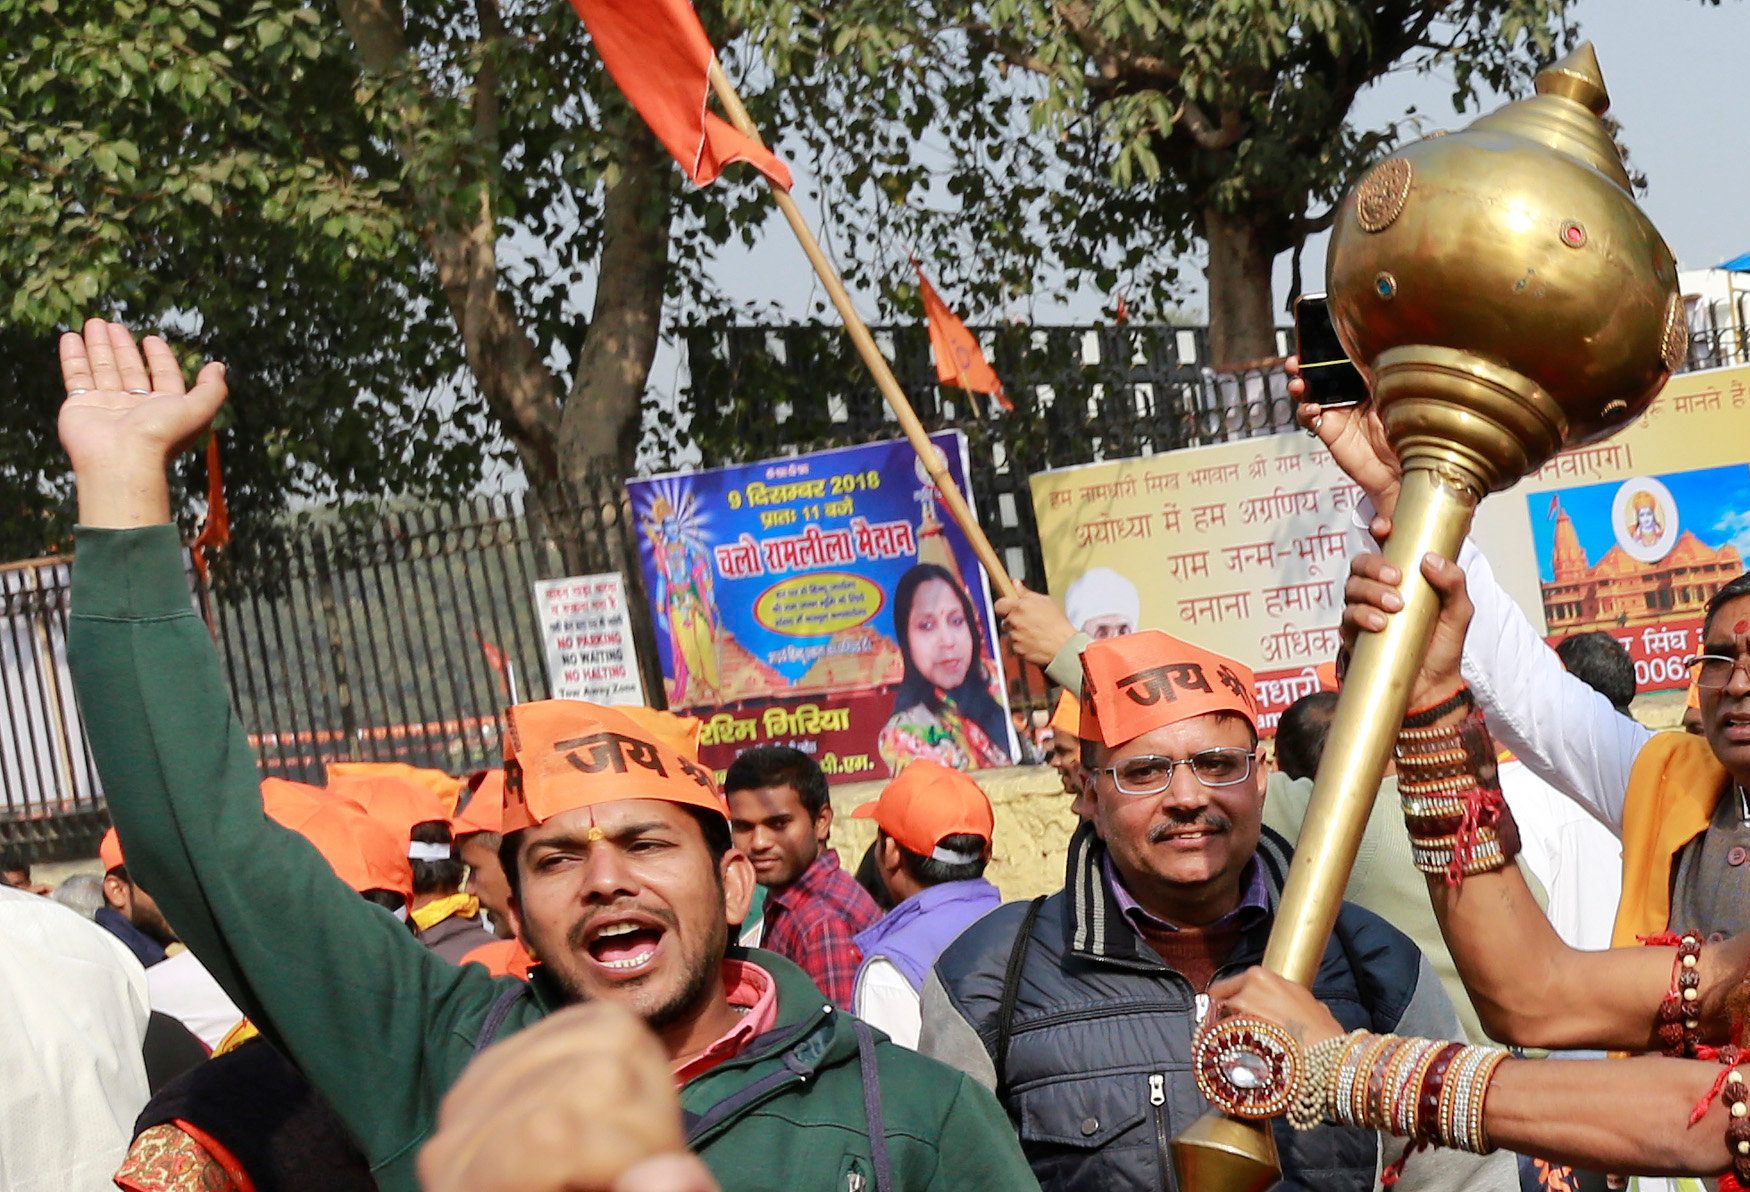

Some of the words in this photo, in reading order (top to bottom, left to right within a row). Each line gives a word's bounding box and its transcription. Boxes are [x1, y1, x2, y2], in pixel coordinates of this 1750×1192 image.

[1674, 386, 1722, 414] मानते
[727, 489, 742, 510] 9
[830, 470, 881, 493] 2018
[1049, 487, 1073, 510] हम
[1078, 476, 1137, 501] नामधारी
[1145, 470, 1179, 492] सिख
[1188, 463, 1241, 485] भगवान
[1249, 453, 1267, 478] श्री
[1275, 454, 1301, 473] राम
[802, 504, 820, 521] 11
[824, 497, 855, 518] बजे
[1075, 511, 1153, 548] अयोध्या
[1162, 502, 1182, 533] में
[1191, 503, 1227, 529] हम
[715, 533, 763, 578] चलो
[763, 522, 854, 572] रामलीला
[853, 516, 916, 560] मैदान
[1167, 551, 1210, 581] राम
[1261, 580, 1335, 619] हमारा
[557, 637, 573, 650] NO
[576, 632, 622, 646] PARKING
[561, 654, 577, 665] NO
[580, 648, 624, 665] WAITING
[1260, 622, 1341, 663] अधिक
[564, 669, 580, 683] NO
[582, 665, 626, 681] HALTING
[1117, 663, 1214, 706] जय
[700, 712, 757, 746] रश्मि
[763, 703, 851, 739] गिरिया
[553, 731, 669, 779] जय
